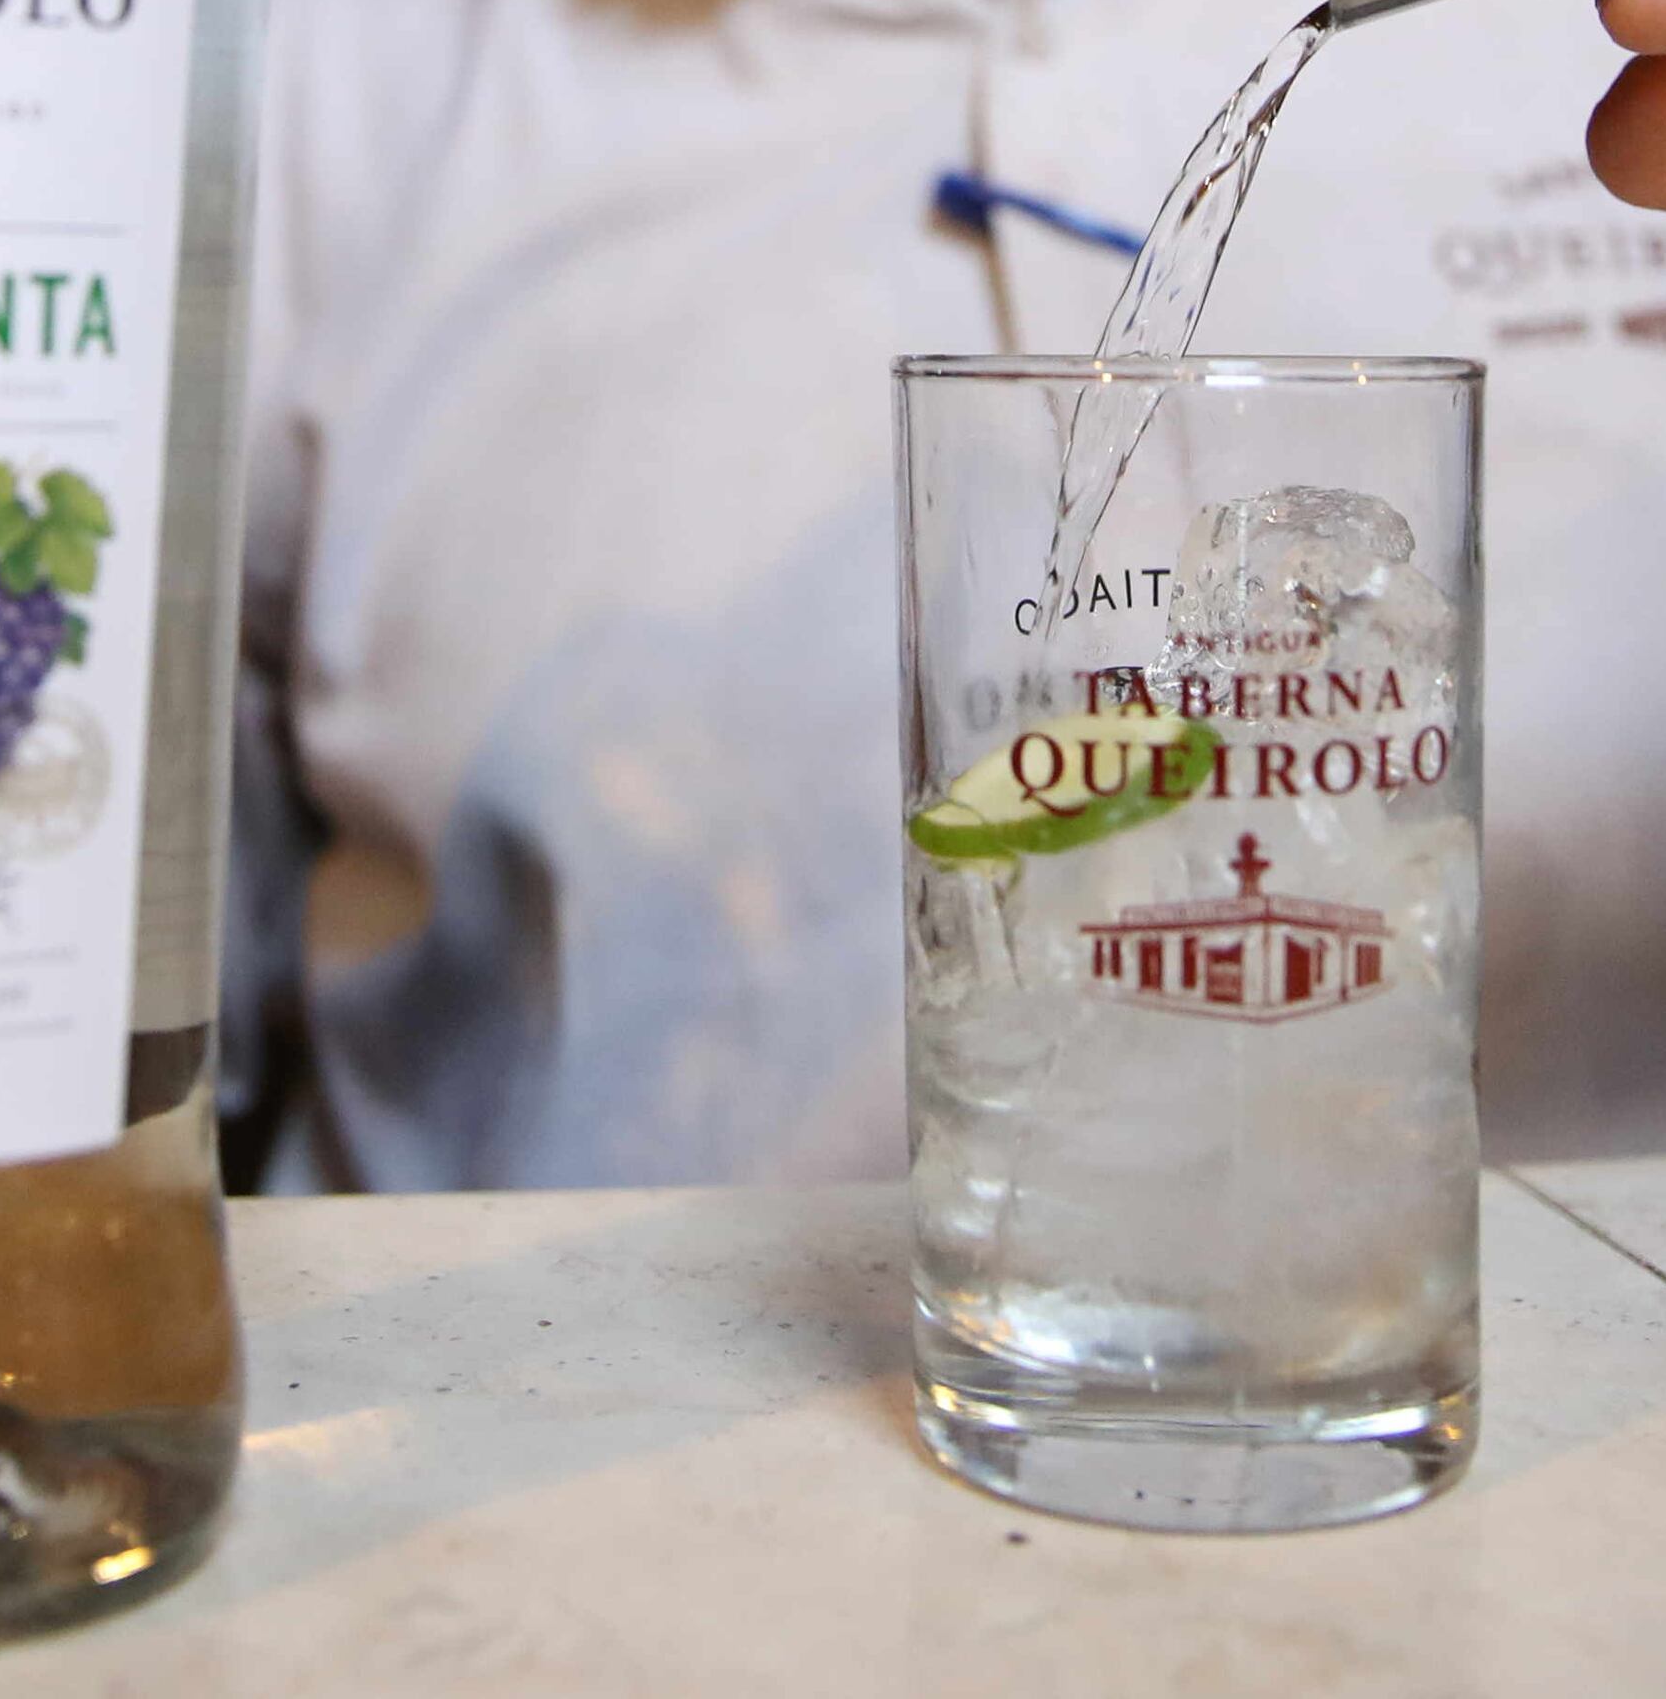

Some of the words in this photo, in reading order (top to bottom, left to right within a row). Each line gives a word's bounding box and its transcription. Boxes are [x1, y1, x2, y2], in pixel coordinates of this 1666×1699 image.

[1173, 630, 1322, 653] ANTIGUA
[1073, 667, 1406, 721] TABERNA
[1009, 725, 1449, 818] QUEIROLO
